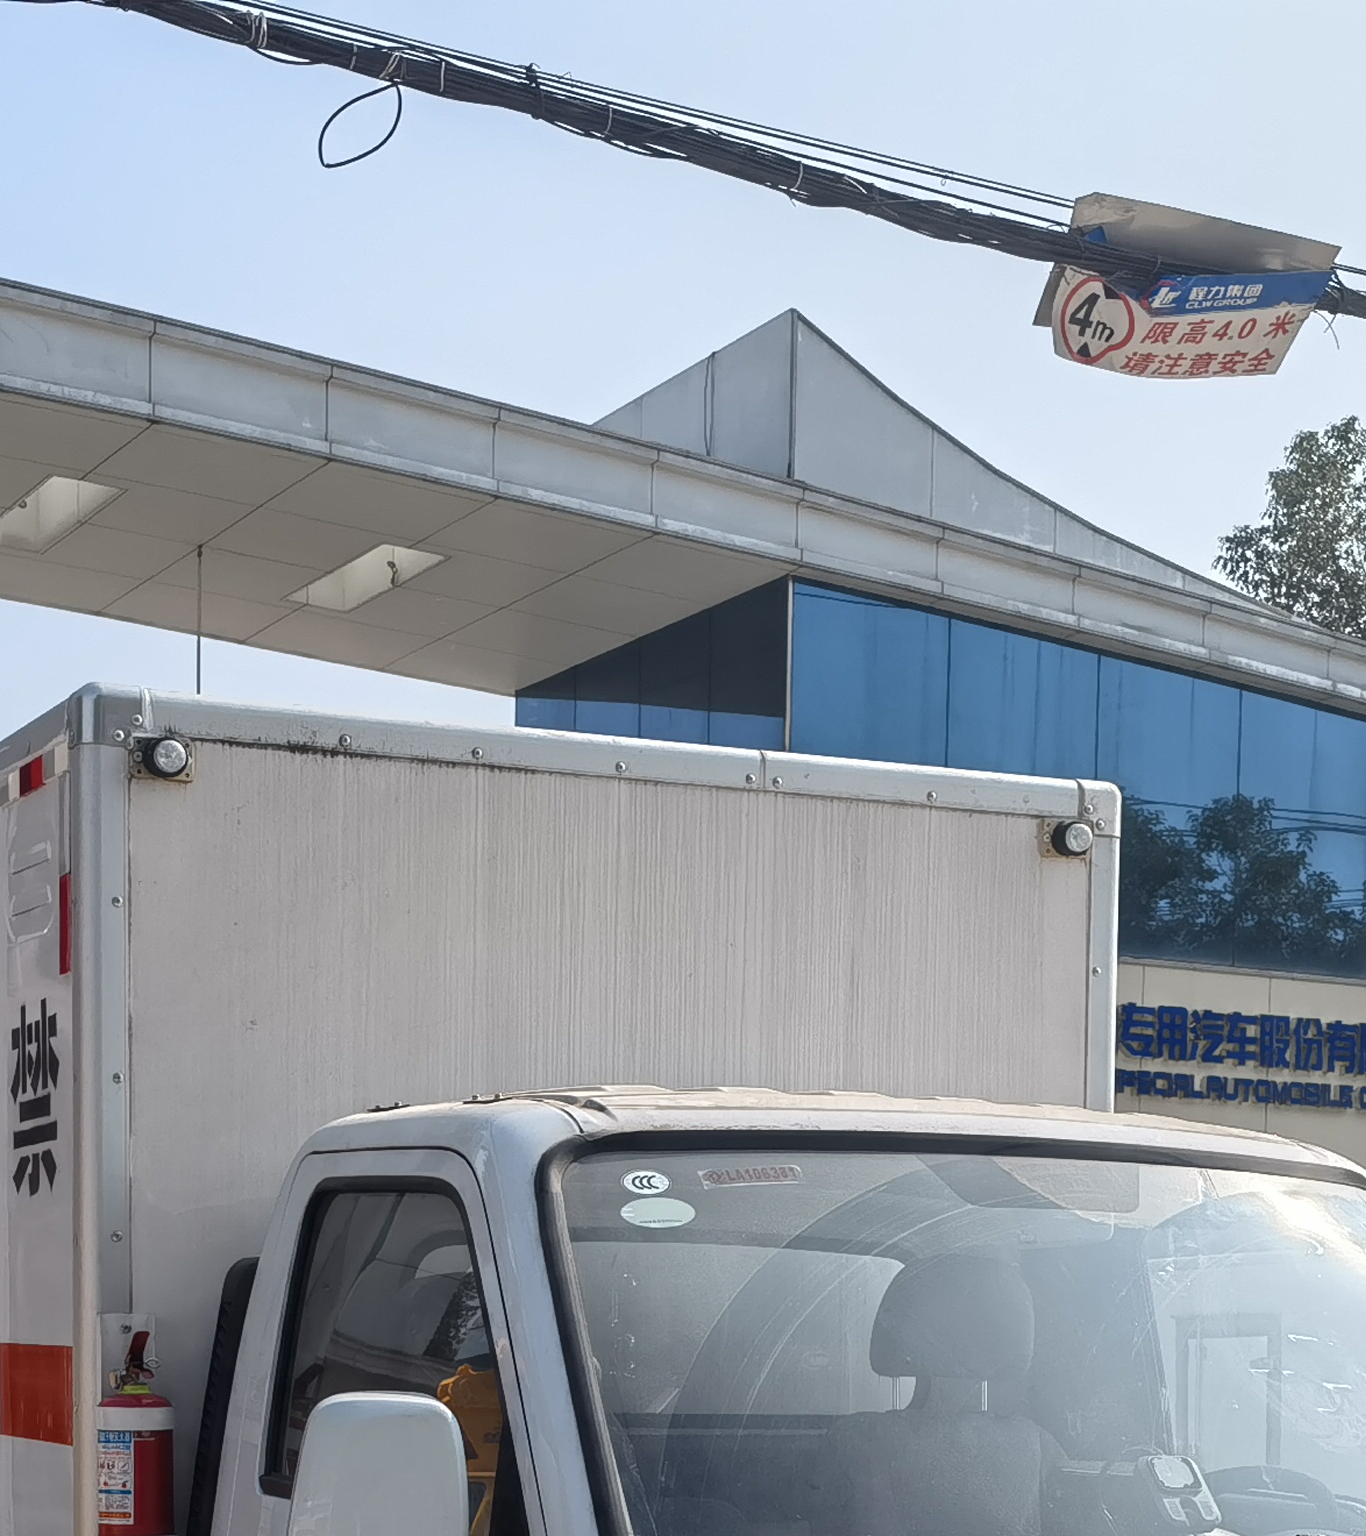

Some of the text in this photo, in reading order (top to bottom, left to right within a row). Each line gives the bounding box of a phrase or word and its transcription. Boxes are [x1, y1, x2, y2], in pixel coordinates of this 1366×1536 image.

[1120, 348, 1276, 377] 请注意安全
